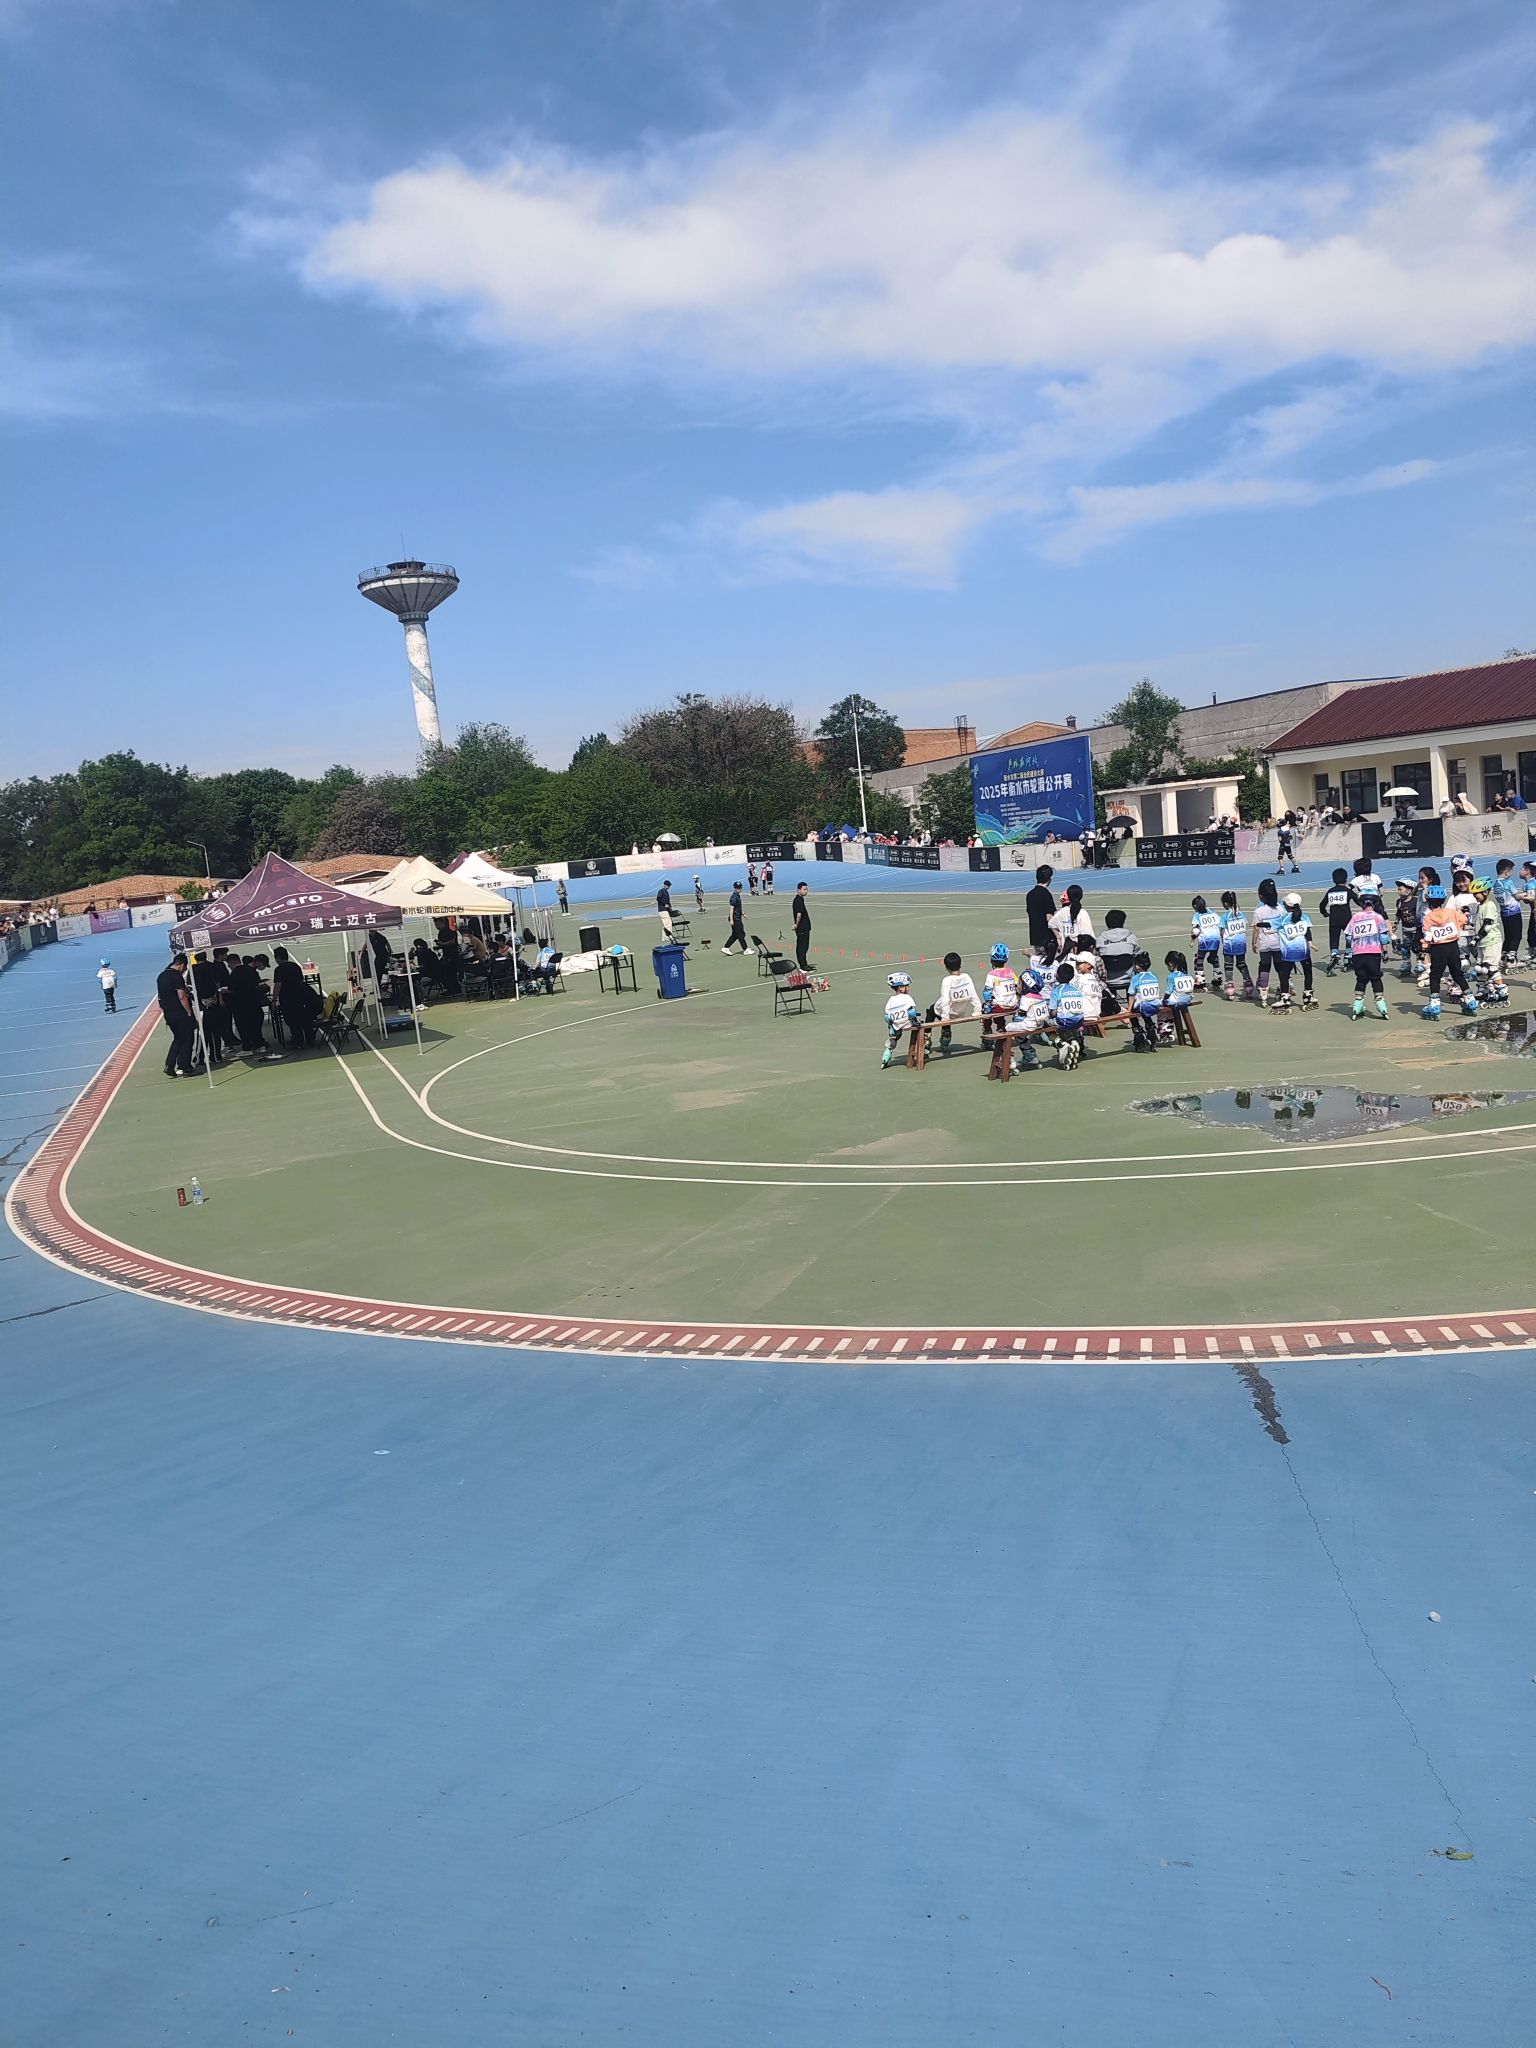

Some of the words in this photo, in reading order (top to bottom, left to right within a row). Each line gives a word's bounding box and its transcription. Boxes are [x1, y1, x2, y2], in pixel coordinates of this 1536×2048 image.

[979, 773, 1072, 800] 2025年衡水市轮滑公开赛
[1481, 824, 1502, 838] 米高
[1329, 895, 1345, 903] 048
[310, 912, 377, 929] 瑞士迈古
[1201, 915, 1216, 925] 001
[1229, 921, 1245, 932] 004
[1286, 924, 1305, 934] 015
[1354, 924, 1373, 934] 027
[1433, 926, 1454, 938] 029
[1040, 972, 1052, 981] 46
[1177, 980, 1193, 990] 011
[953, 988, 970, 1000] 021
[1142, 986, 1159, 997] 007
[1064, 1001, 1082, 1010] 006
[890, 1009, 906, 1021] 022
